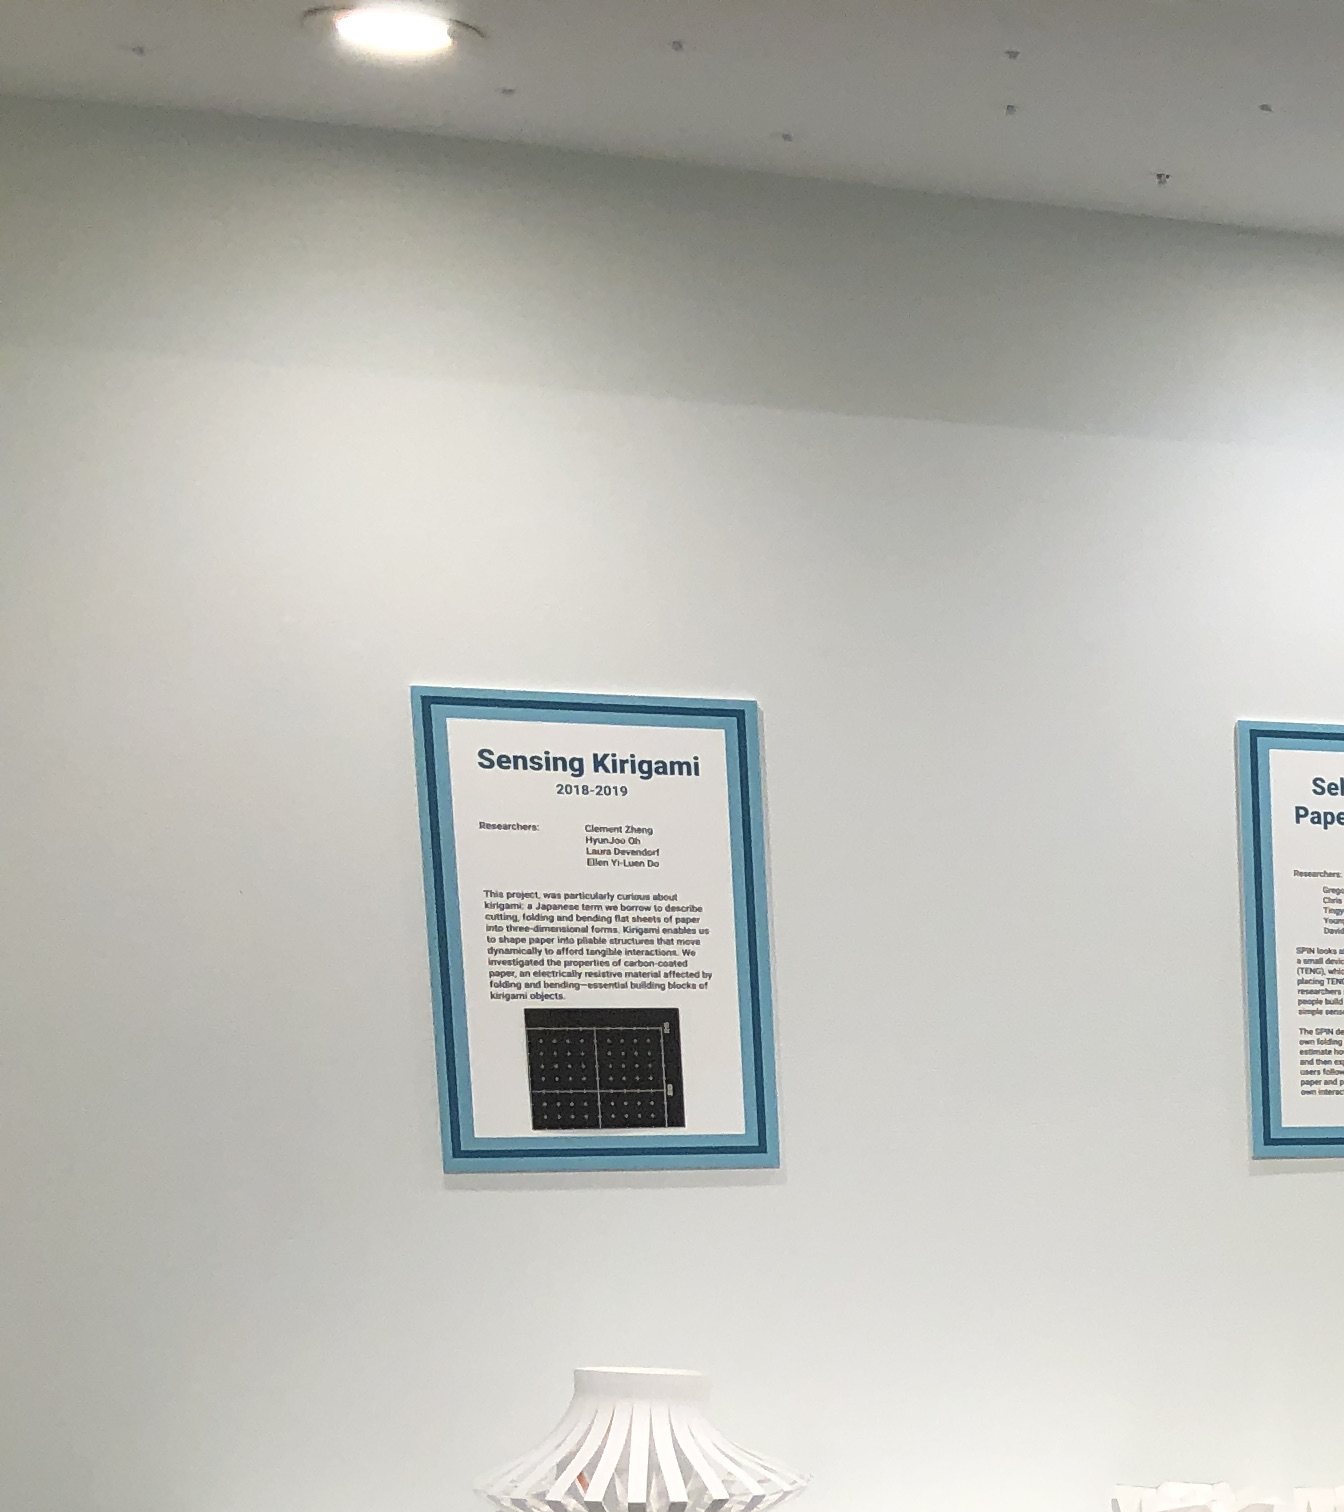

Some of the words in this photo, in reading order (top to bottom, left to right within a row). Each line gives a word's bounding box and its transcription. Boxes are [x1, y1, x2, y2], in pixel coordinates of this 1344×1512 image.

[477, 748, 584, 777] Sensing
[592, 752, 700, 780] Kirigami
[556, 784, 627, 796] 2018-2019
[478, 822, 539, 831] Researchers:
[584, 825, 622, 833] Clement
[625, 826, 653, 836] Zheng
[627, 837, 640, 845] Oh
[586, 847, 611, 855] Laura
[586, 859, 608, 867] Ellen
[647, 860, 659, 868] Do
[1293, 870, 1342, 878] Researchers:
[484, 890, 503, 899] This
[563, 891, 614, 902] particularly
[616, 892, 650, 901] curious
[652, 892, 677, 901] about
[535, 902, 579, 913] Japanese
[581, 902, 602, 911] term
[620, 903, 651, 912] borrow
[653, 903, 662, 912] to
[664, 903, 702, 912] describe
[522, 913, 554, 923] folding
[556, 913, 573, 922] and
[575, 913, 612, 924] bending
[614, 914, 629, 922] flat
[631, 914, 661, 923] sheets
[663, 914, 672, 923] of
[674, 917, 699, 925] paper
[485, 924, 503, 932] into
[591, 925, 618, 933] forms.
[622, 925, 660, 936] Kirigami
[661, 926, 696, 934] enables
[486, 935, 496, 943] to
[498, 935, 526, 945] shape
[528, 937, 554, 946] paper
[557, 935, 574, 944] into
[576, 936, 606, 946] pliable
[609, 936, 654, 945] structures
[656, 936, 674, 945] that
[487, 946, 542, 957] dynamically
[544, 947, 554, 955] to
[555, 947, 584, 955] afford
[585, 947, 622, 958] tangible
[681, 948, 695, 956] We
[487, 958, 544, 968] investigated
[546, 958, 561, 966] the
[563, 958, 610, 969] properties
[611, 958, 621, 967] of
[623, 958, 688, 967] carbon-coated
[488, 971, 517, 979] paper,
[532, 969, 582, 980] electrically
[584, 969, 622, 978] resistive
[624, 970, 661, 978] material
[663, 970, 700, 979] affected
[701, 970, 712, 981] by
[489, 980, 521, 990] folding
[524, 980, 541, 988] and
[630, 981, 665, 991] building
[667, 981, 696, 989] blocks
[698, 981, 707, 989] of
[490, 991, 527, 1002] kirigami
[1299, 1027, 1313, 1035] The
[1314, 1027, 1333, 1035] SPIN
